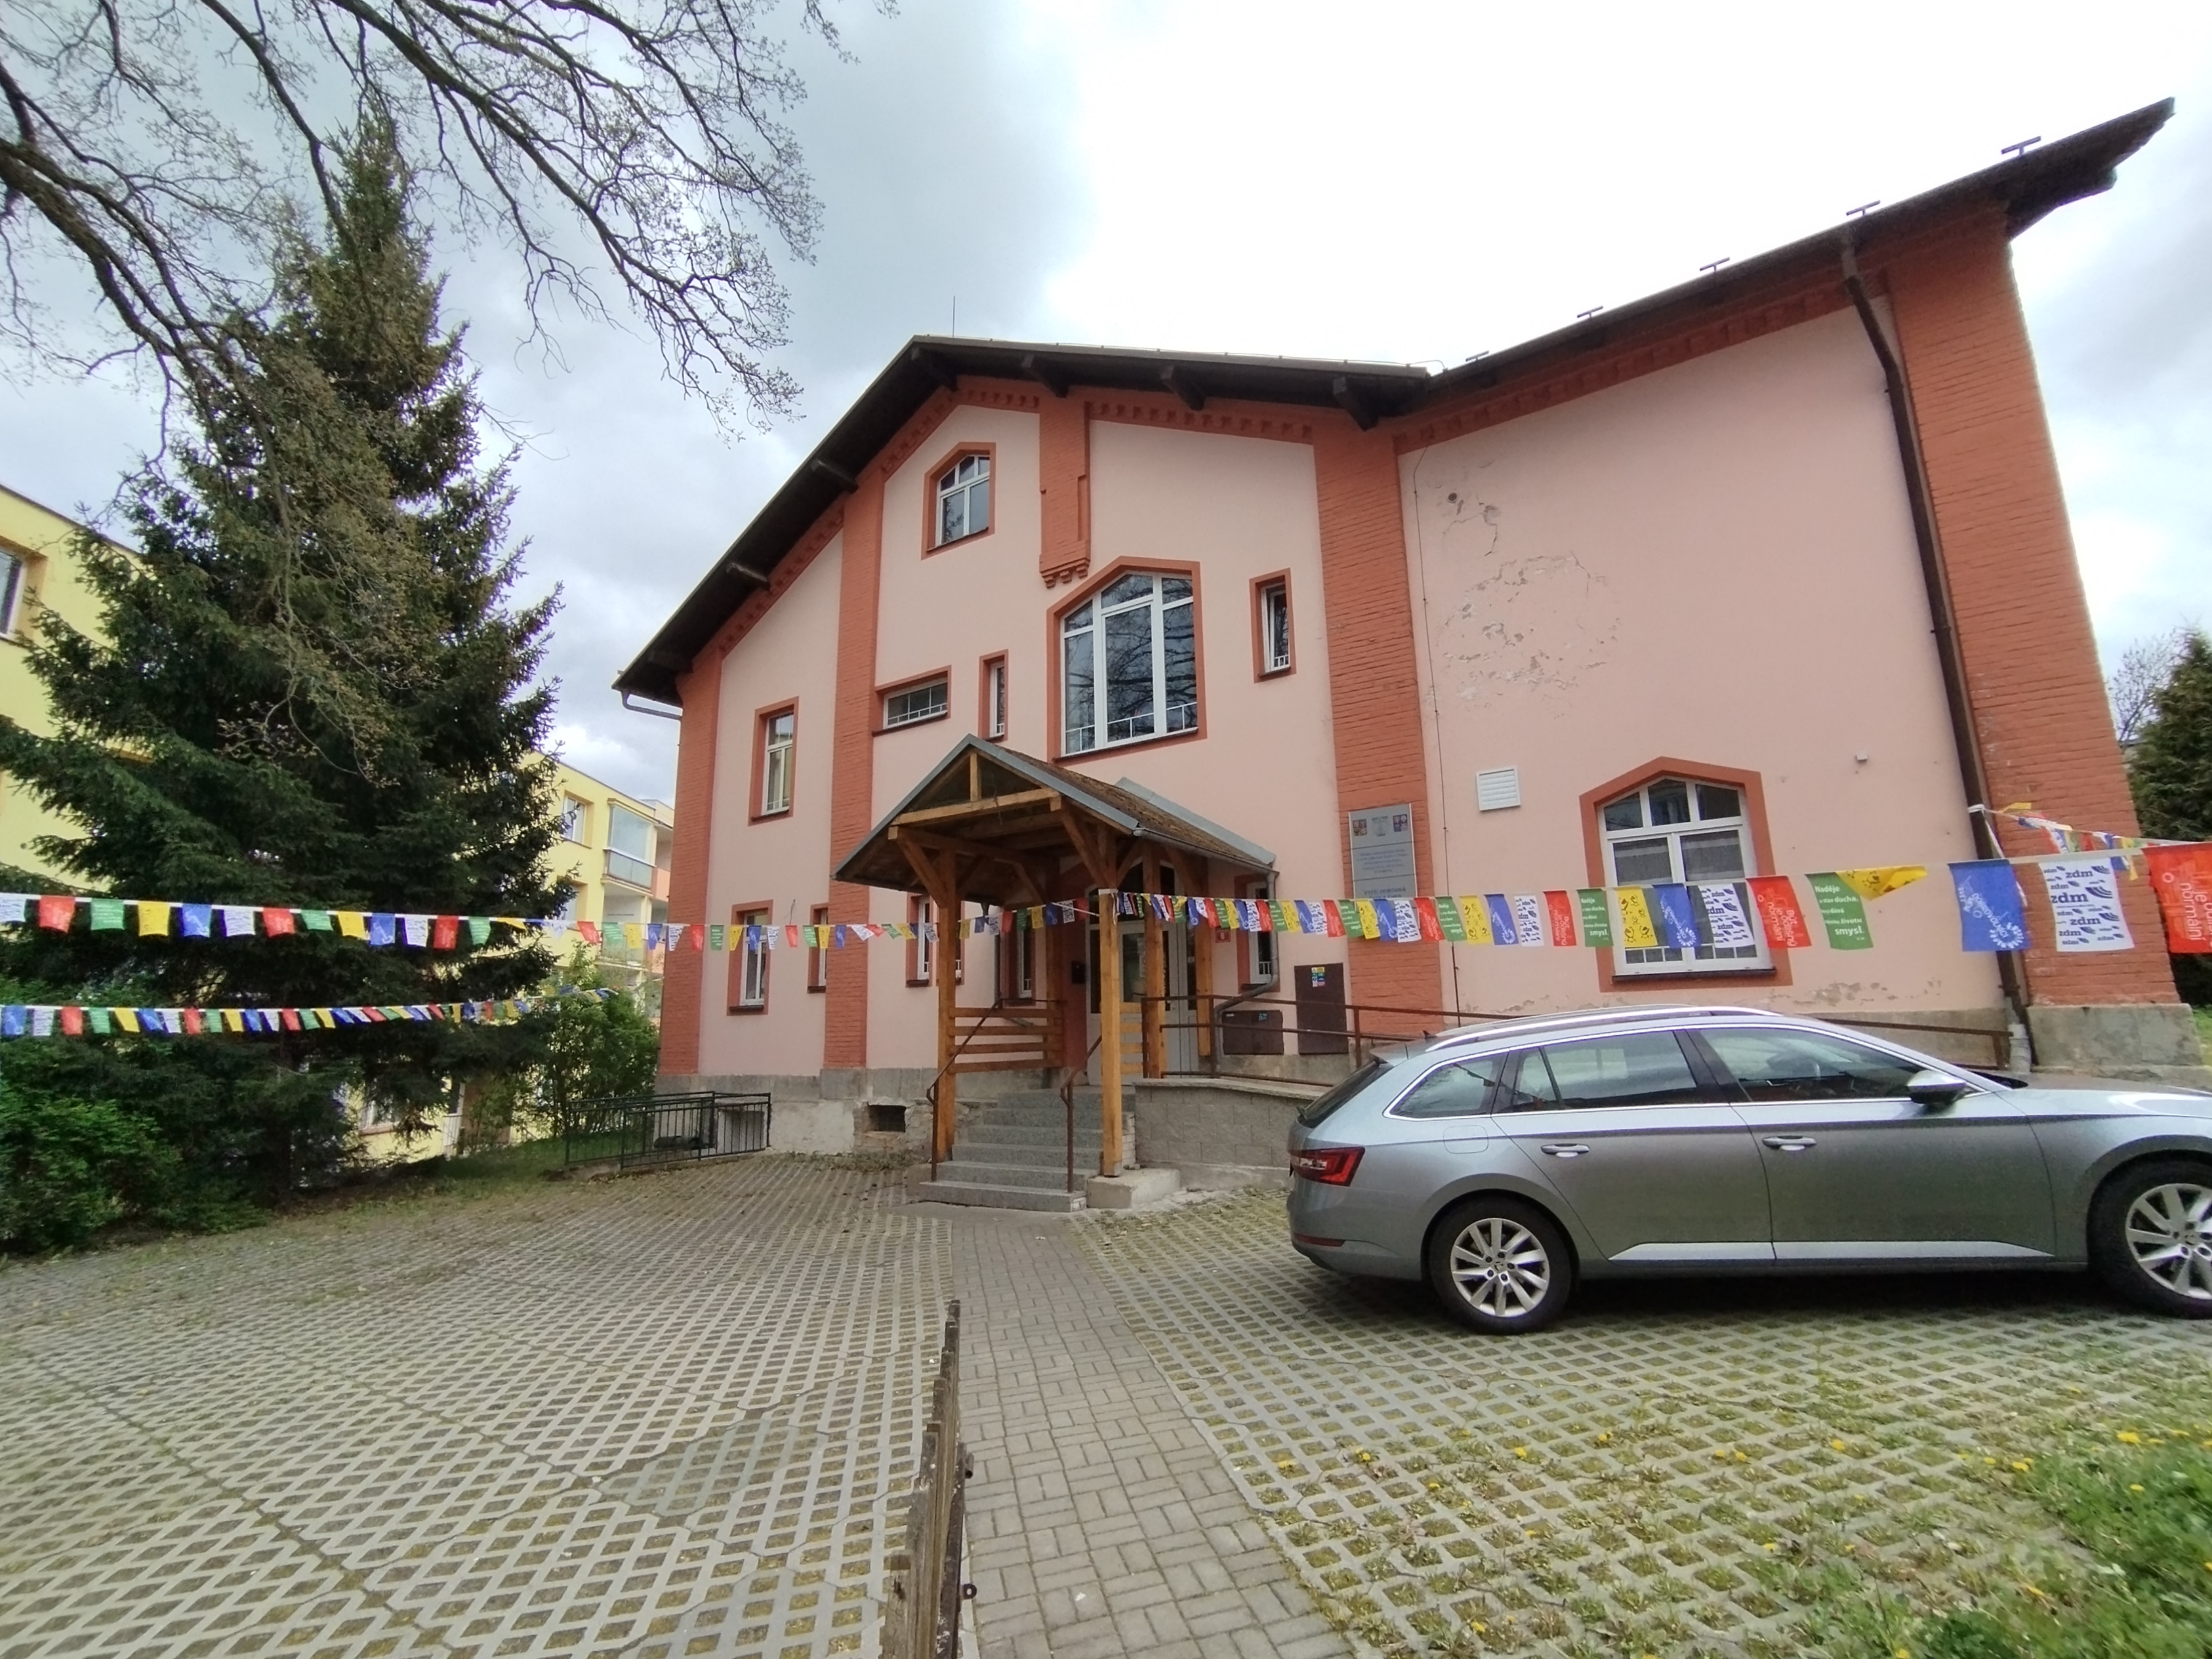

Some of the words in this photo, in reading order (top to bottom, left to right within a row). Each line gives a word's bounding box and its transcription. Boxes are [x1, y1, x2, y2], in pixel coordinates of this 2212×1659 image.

[2065, 869, 2094, 878] zdm
[1814, 885, 1840, 894] Naděje
[2051, 892, 2089, 904] zdm
[2180, 883, 2207, 941] normální
[2070, 916, 2102, 926] zdm
